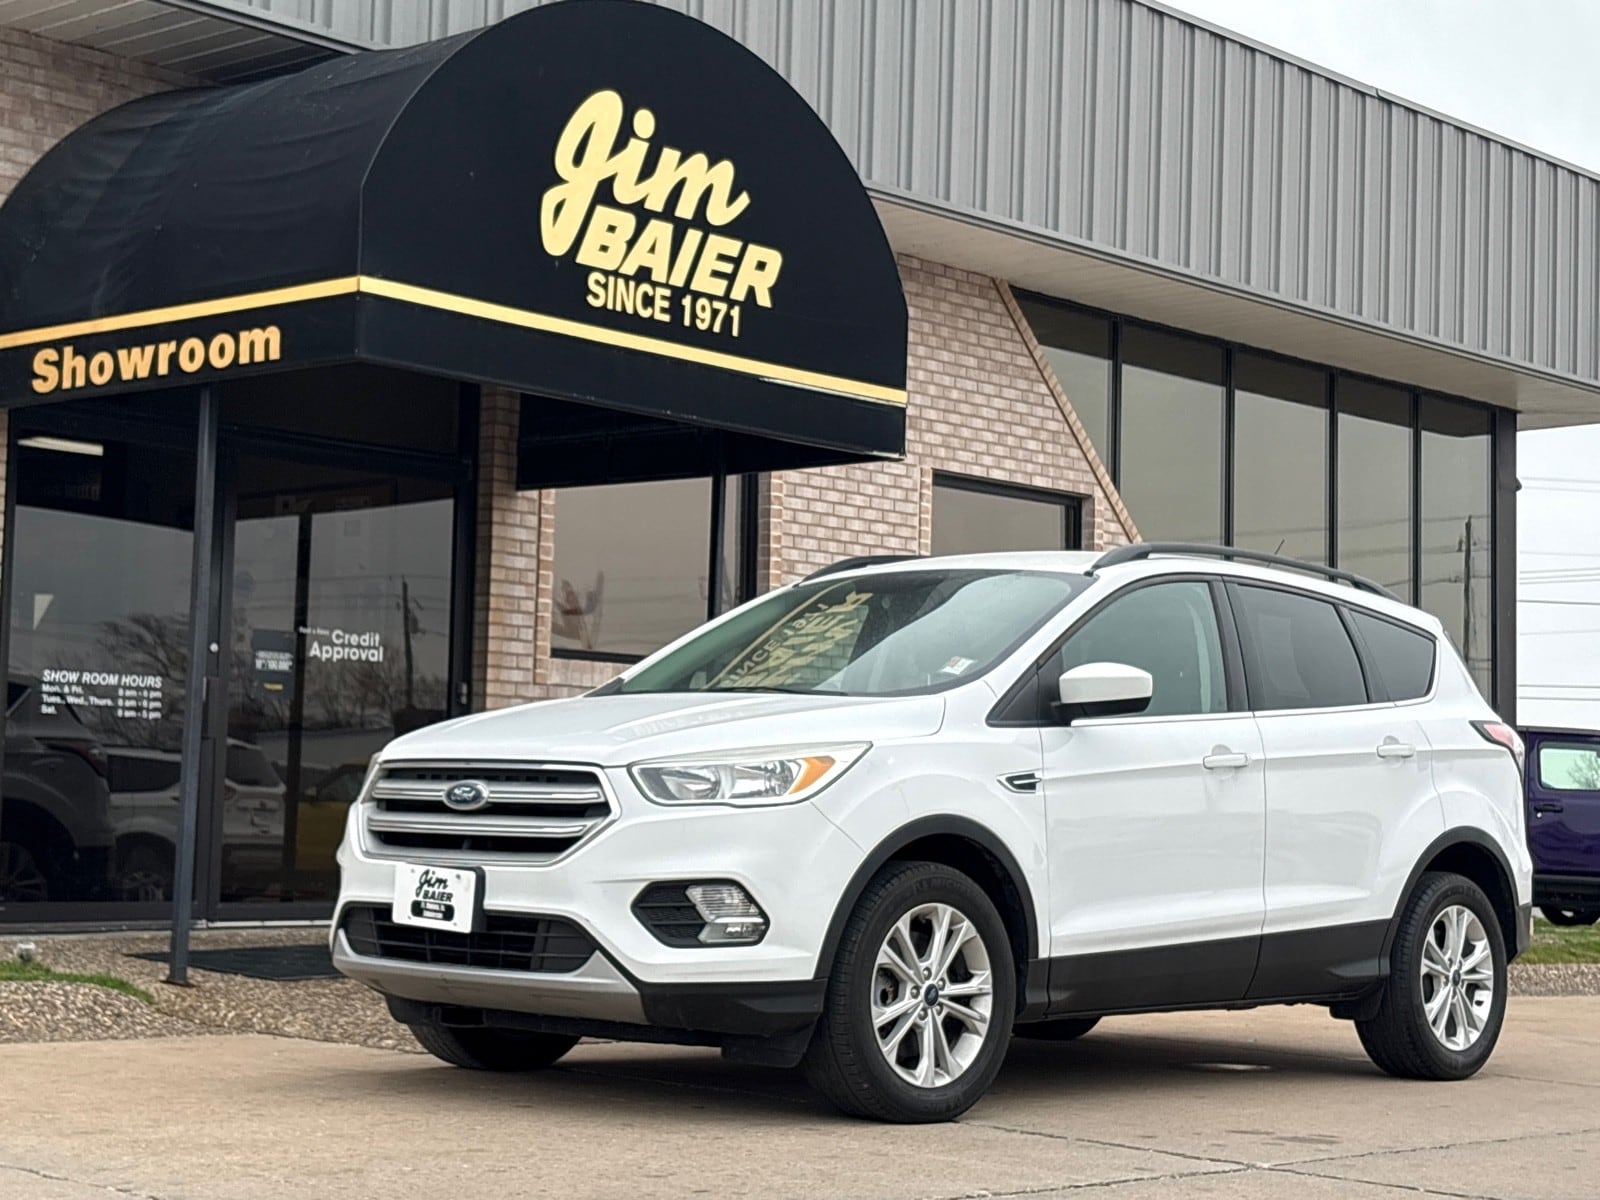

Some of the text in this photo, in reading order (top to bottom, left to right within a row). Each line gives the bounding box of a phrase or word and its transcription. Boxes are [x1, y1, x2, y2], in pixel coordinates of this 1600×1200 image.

[540, 90, 750, 256] Jim
[575, 205, 782, 308] BAIER
[586, 271, 741, 337] SINCE 1971
[31, 325, 281, 394] Showroom
[309, 641, 384, 662] Approval
[331, 630, 380, 647] Credit
[42, 669, 163, 689] SHOW ROOM HOURS
[415, 868, 448, 898] Jim
[422, 889, 454, 902] BAIER
